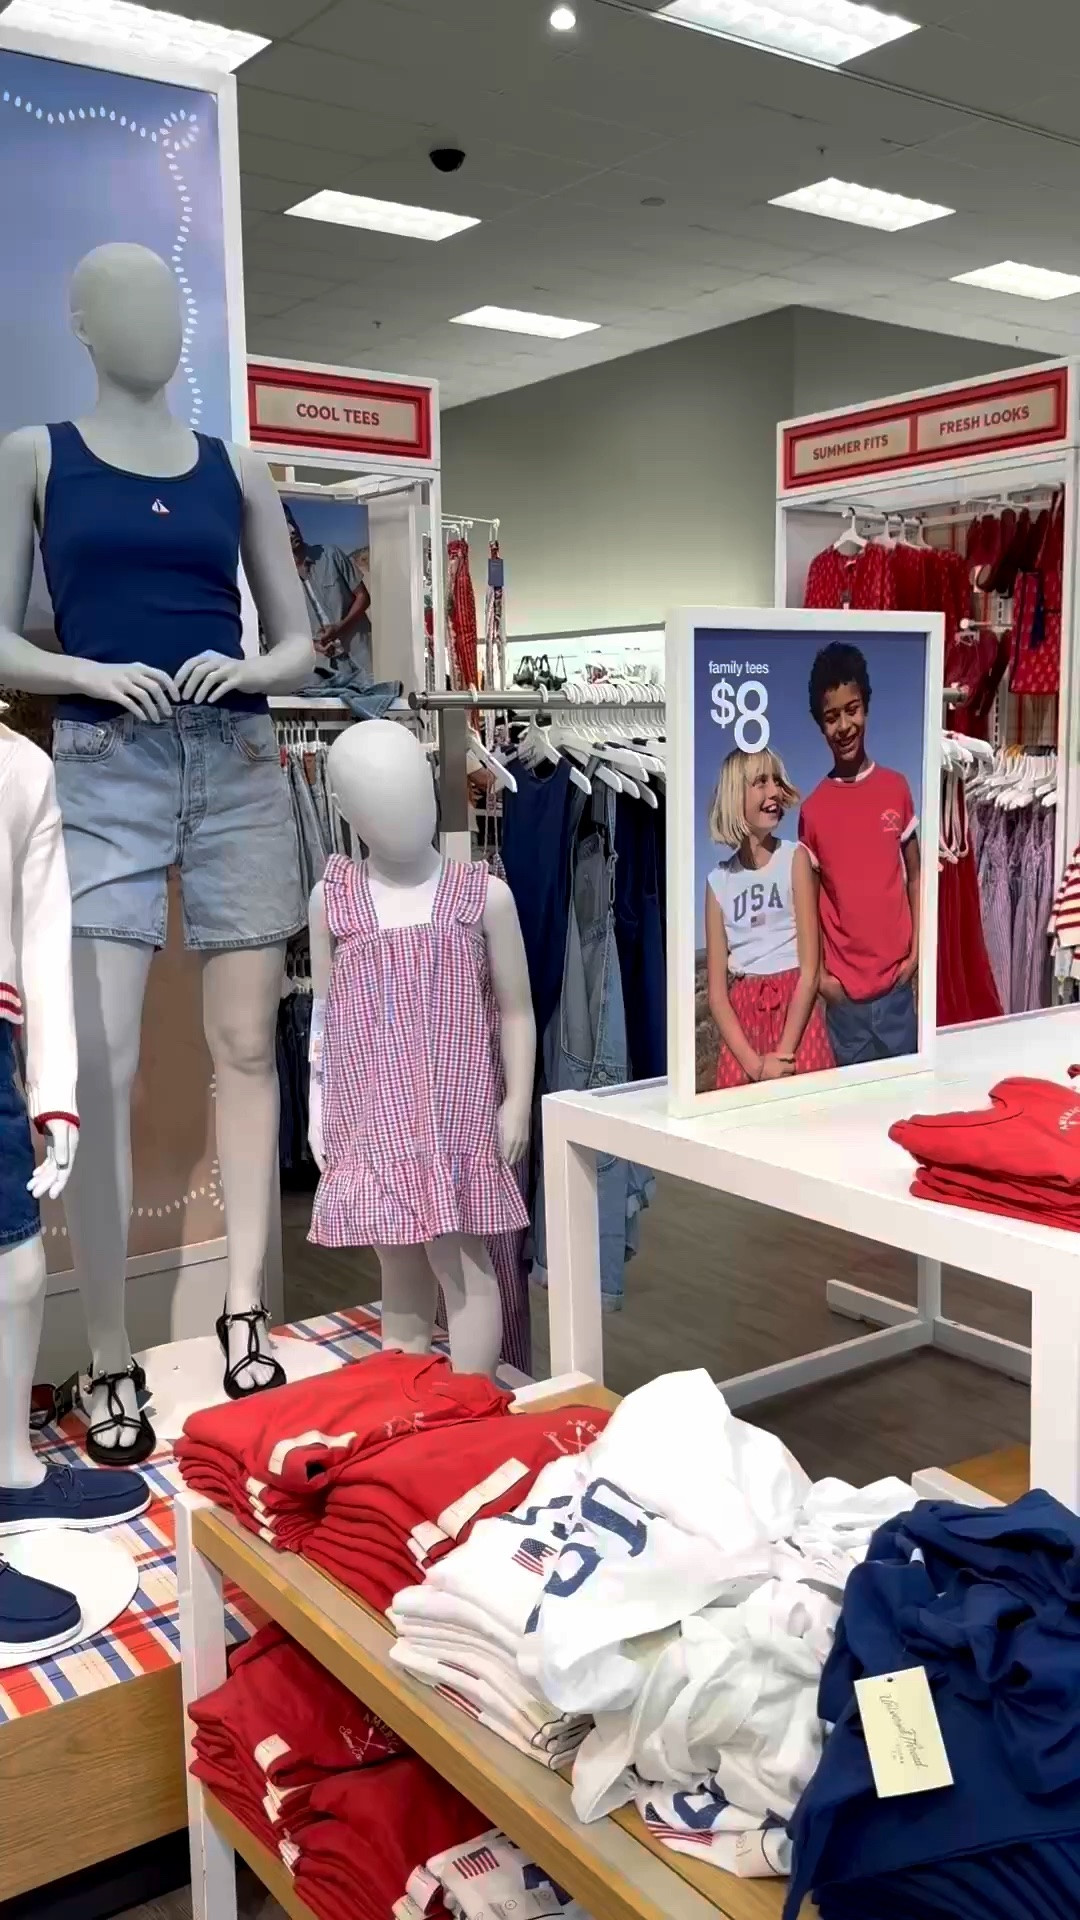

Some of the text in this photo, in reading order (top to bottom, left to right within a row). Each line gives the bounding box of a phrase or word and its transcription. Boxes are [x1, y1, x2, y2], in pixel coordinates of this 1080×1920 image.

[296, 403, 380, 426] COOL TEES
[939, 406, 1030, 436] FRESH LOOKS
[812, 434, 889, 461] SUMMER FITS
[708, 660, 769, 677] family tees
[710, 678, 770, 753] $8
[733, 882, 783, 922] USA
